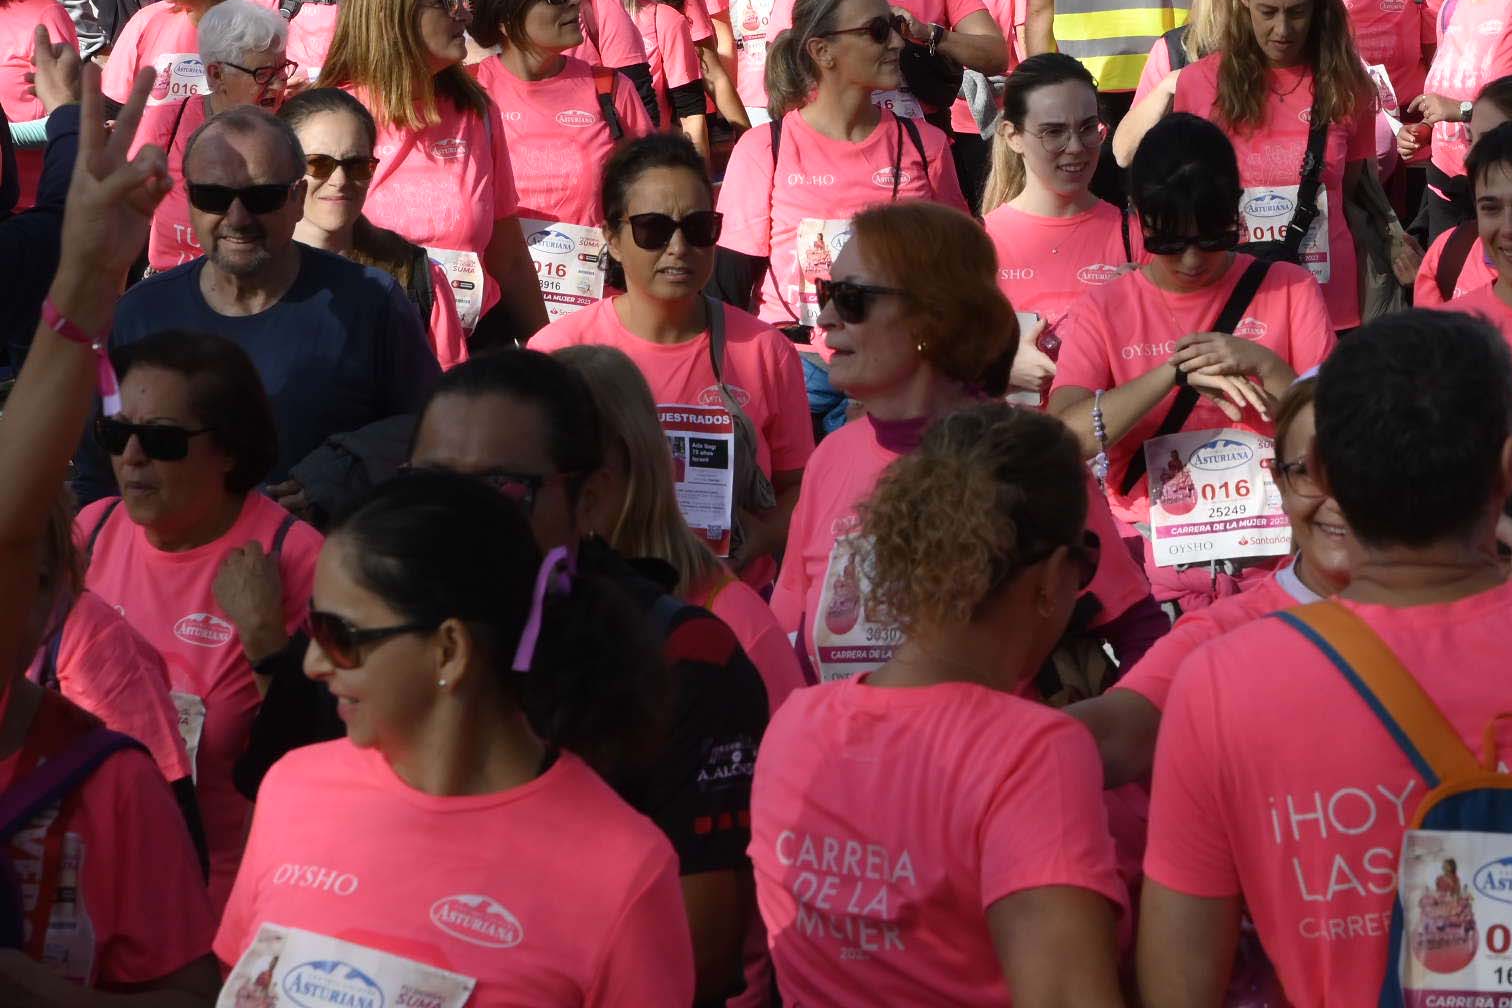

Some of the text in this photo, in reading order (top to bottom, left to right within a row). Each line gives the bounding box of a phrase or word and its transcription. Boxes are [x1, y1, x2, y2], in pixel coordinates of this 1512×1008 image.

[171, 82, 199, 96] 016
[552, 293, 576, 303] MUJER
[1195, 451, 1250, 466] ASTURIANA
[1201, 478, 1251, 502] 016
[1208, 504, 1247, 519] 25249
[1170, 524, 1212, 536] CARRERA
[1212, 522, 1225, 532] DE
[1226, 521, 1238, 530] LA
[1238, 517, 1268, 529] MUJER
[1168, 539, 1215, 555] OYSHO
[1267, 779, 1416, 845] ¡HOY
[1291, 846, 1399, 903] LAS
[847, 881, 890, 920] LA
[437, 903, 515, 944] ASTURIANA
